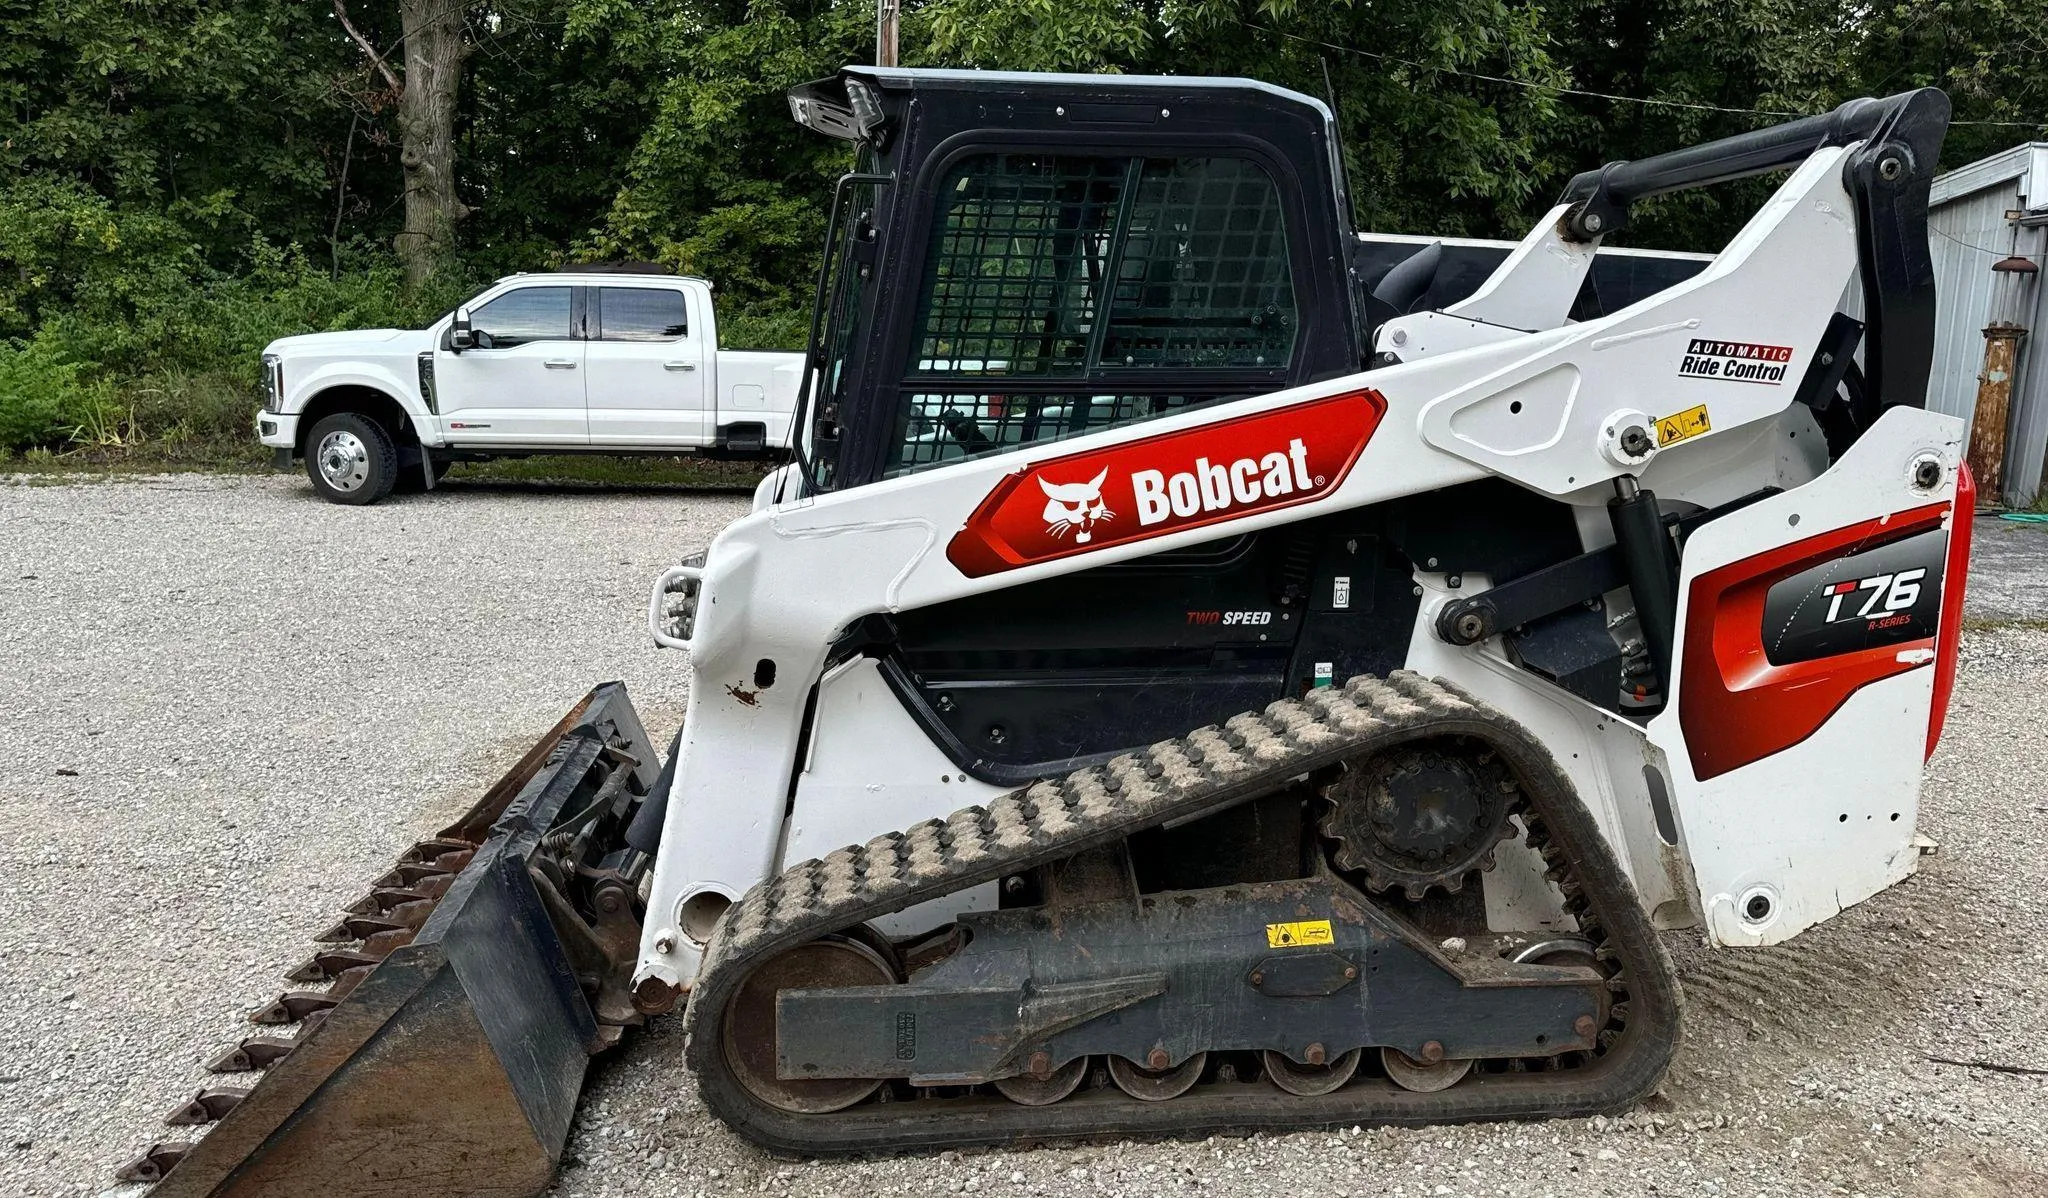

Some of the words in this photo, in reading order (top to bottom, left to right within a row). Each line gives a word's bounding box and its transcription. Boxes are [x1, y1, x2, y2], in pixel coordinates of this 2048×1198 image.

[1691, 341, 1788, 361] AUTOMATIC
[1679, 355, 1720, 376] Ride
[1723, 359, 1787, 382] Control
[1822, 568, 1926, 623] T76
[1186, 611, 1220, 625] TWO
[1222, 611, 1272, 625] SPEED
[1868, 614, 1912, 631] R-SERIES
